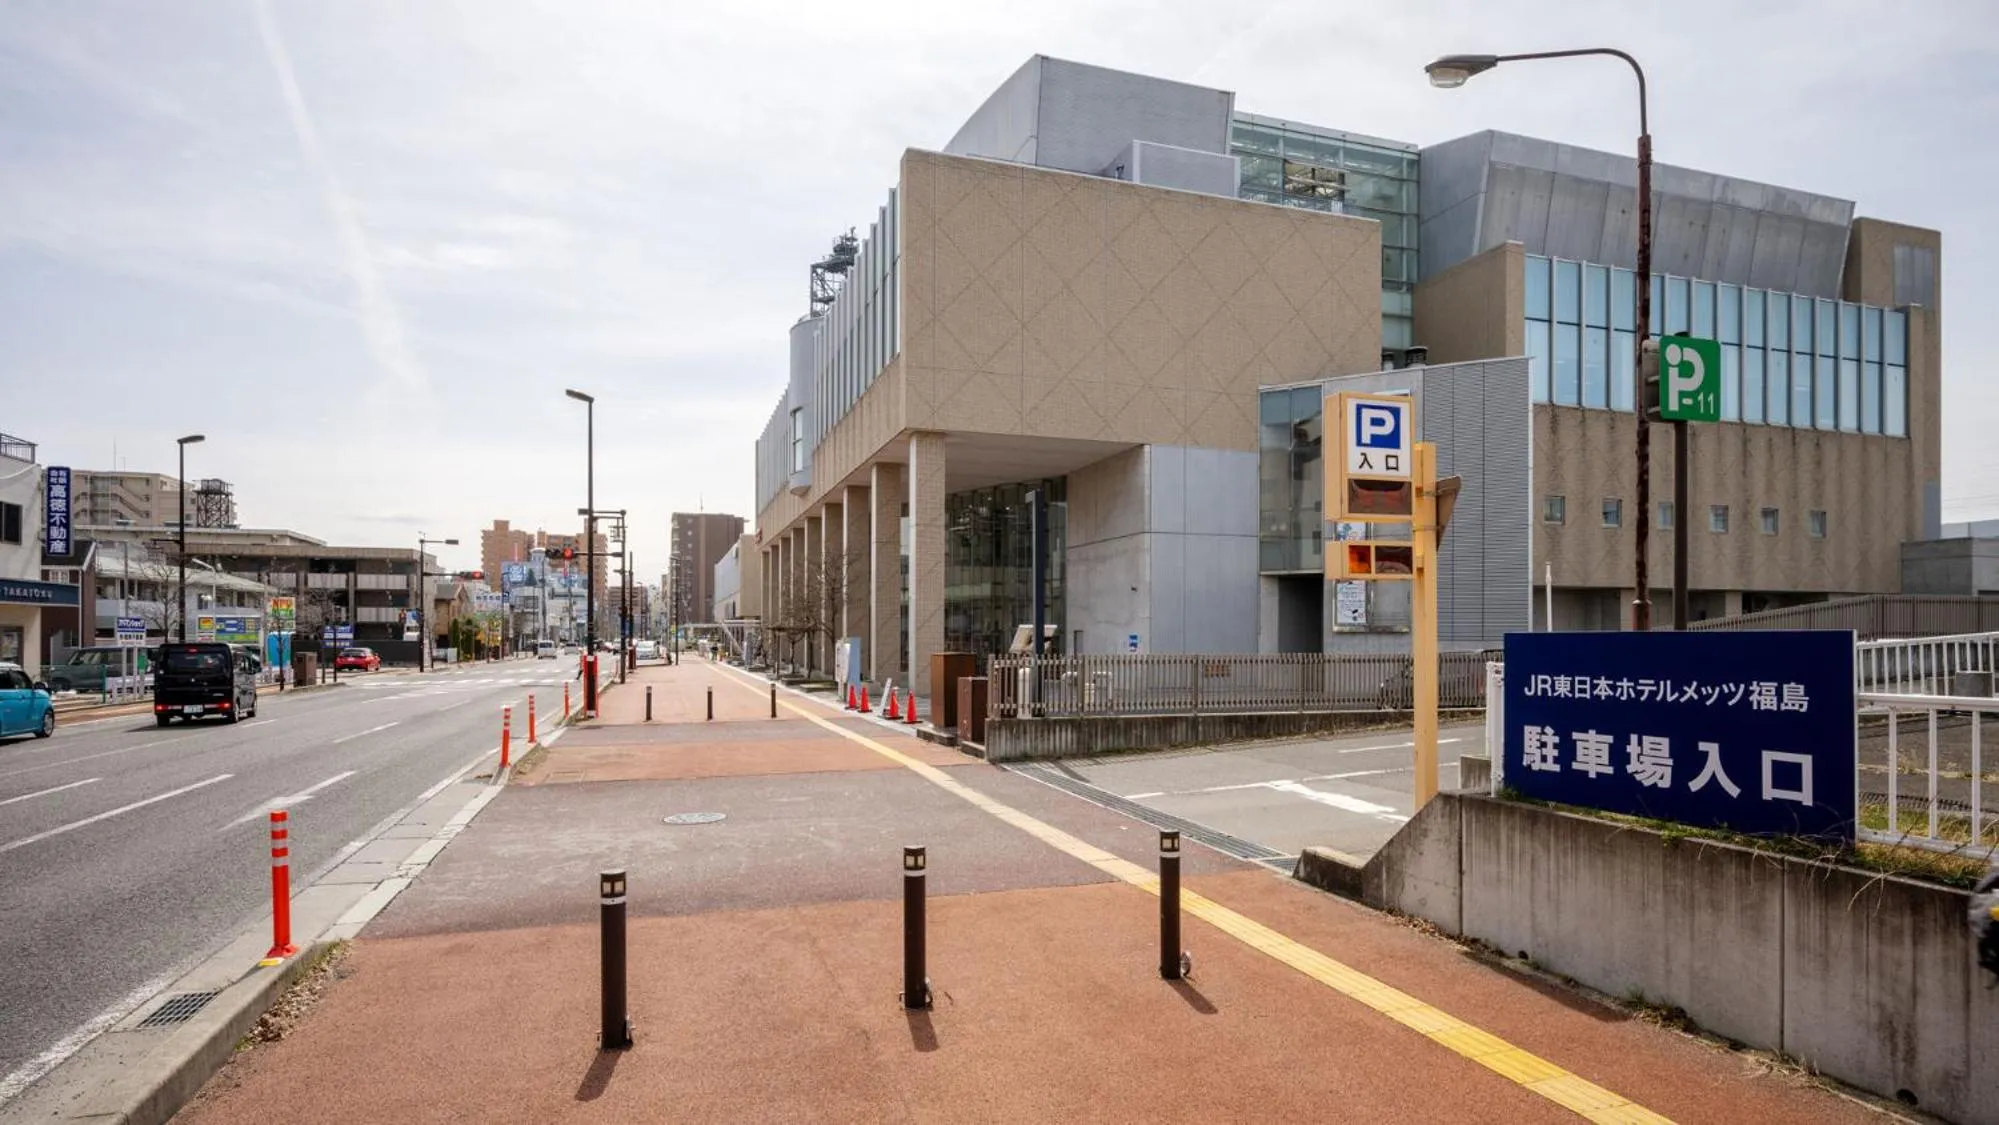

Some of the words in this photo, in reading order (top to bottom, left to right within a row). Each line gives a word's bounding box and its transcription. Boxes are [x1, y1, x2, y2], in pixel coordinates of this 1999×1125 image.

[1361, 407, 1395, 444] P
[1358, 453, 1400, 471] 入口
[49, 485, 68, 553] 高徳不動産
[3, 586, 53, 598] TAKATOKU
[1523, 674, 1809, 713] JR東日本ホテルメッツ福島
[1522, 724, 1814, 807] 駐車場入口
